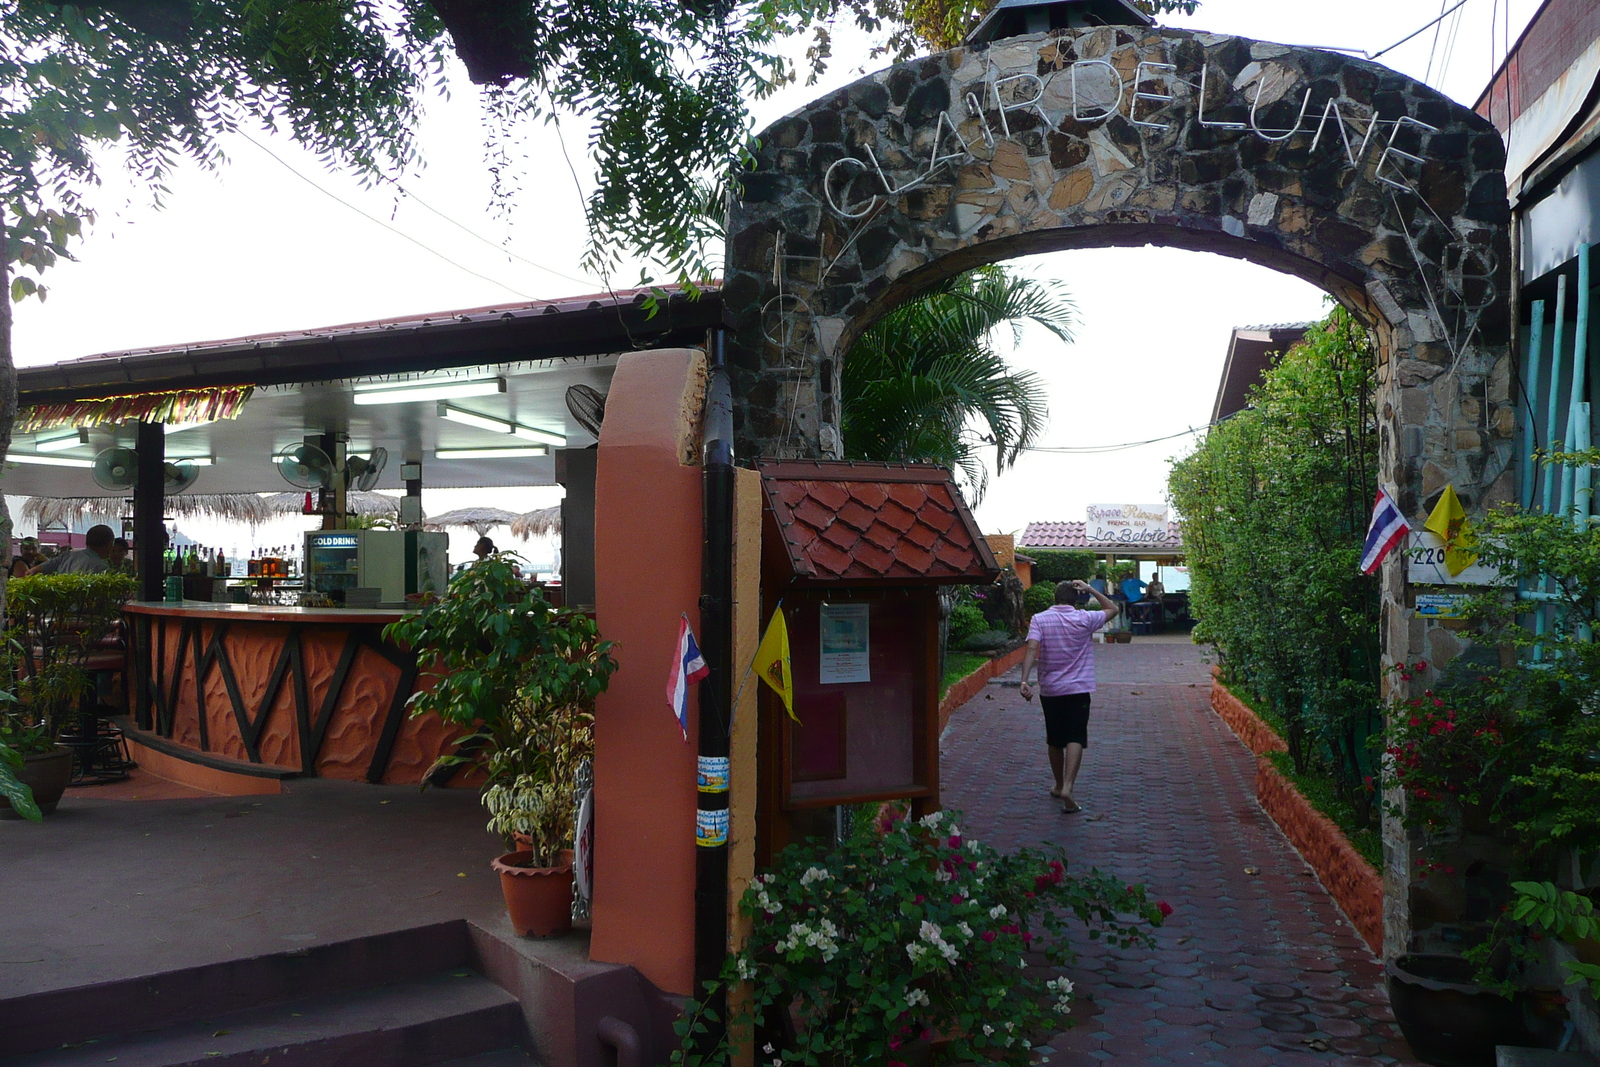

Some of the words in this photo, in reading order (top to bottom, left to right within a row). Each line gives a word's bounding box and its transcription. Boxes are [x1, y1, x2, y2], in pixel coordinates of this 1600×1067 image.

[824, 73, 1053, 218] CLAIR
[1070, 60, 1177, 131] DE
[1199, 63, 1439, 193] LUNE
[313, 537, 332, 546] COLD
[1086, 526, 1116, 542] La
[1117, 528, 1168, 543] Belote
